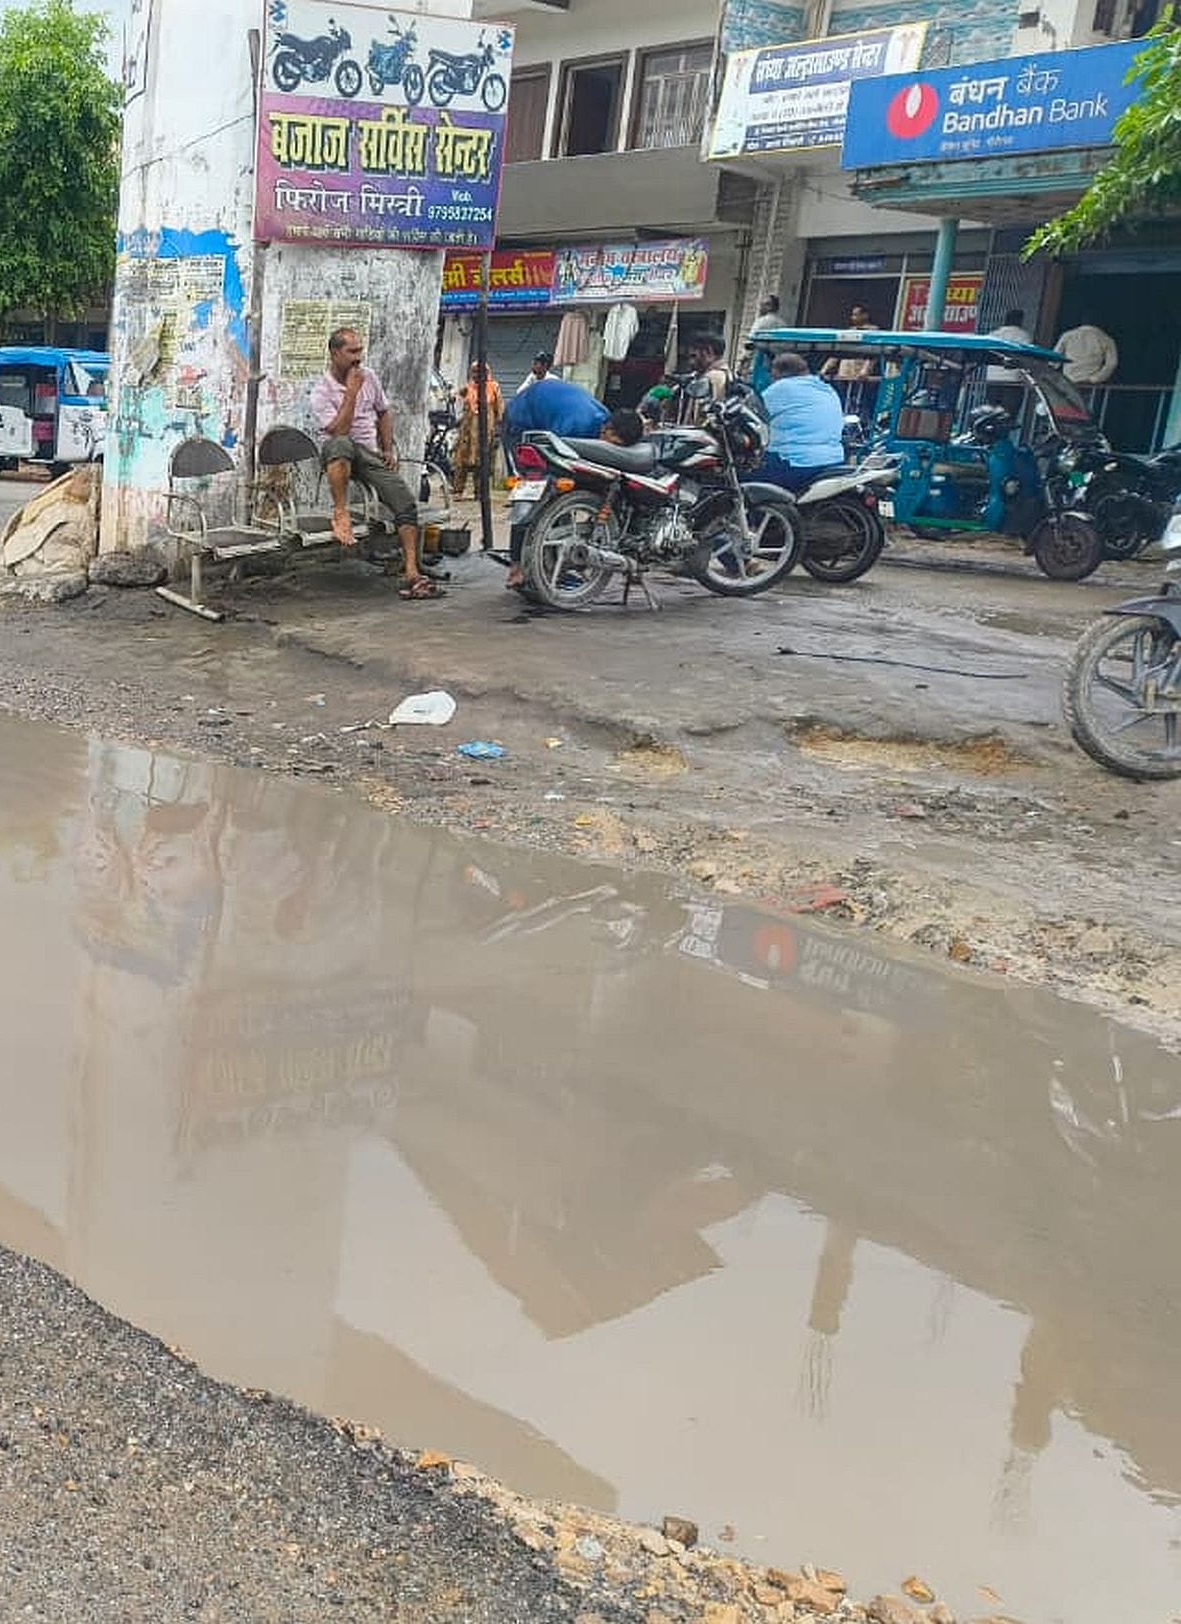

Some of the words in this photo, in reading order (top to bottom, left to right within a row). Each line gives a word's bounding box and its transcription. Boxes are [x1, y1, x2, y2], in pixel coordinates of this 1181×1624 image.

[949, 76, 1009, 104] बंधन
[1015, 62, 1062, 94] बैंक
[942, 103, 1043, 134] Bandhan
[1049, 92, 1109, 124] Bank
[269, 111, 351, 168] बजाज
[357, 106, 427, 172] सर्विस
[434, 111, 493, 177] सेन्टर
[275, 178, 352, 213] फिरोज
